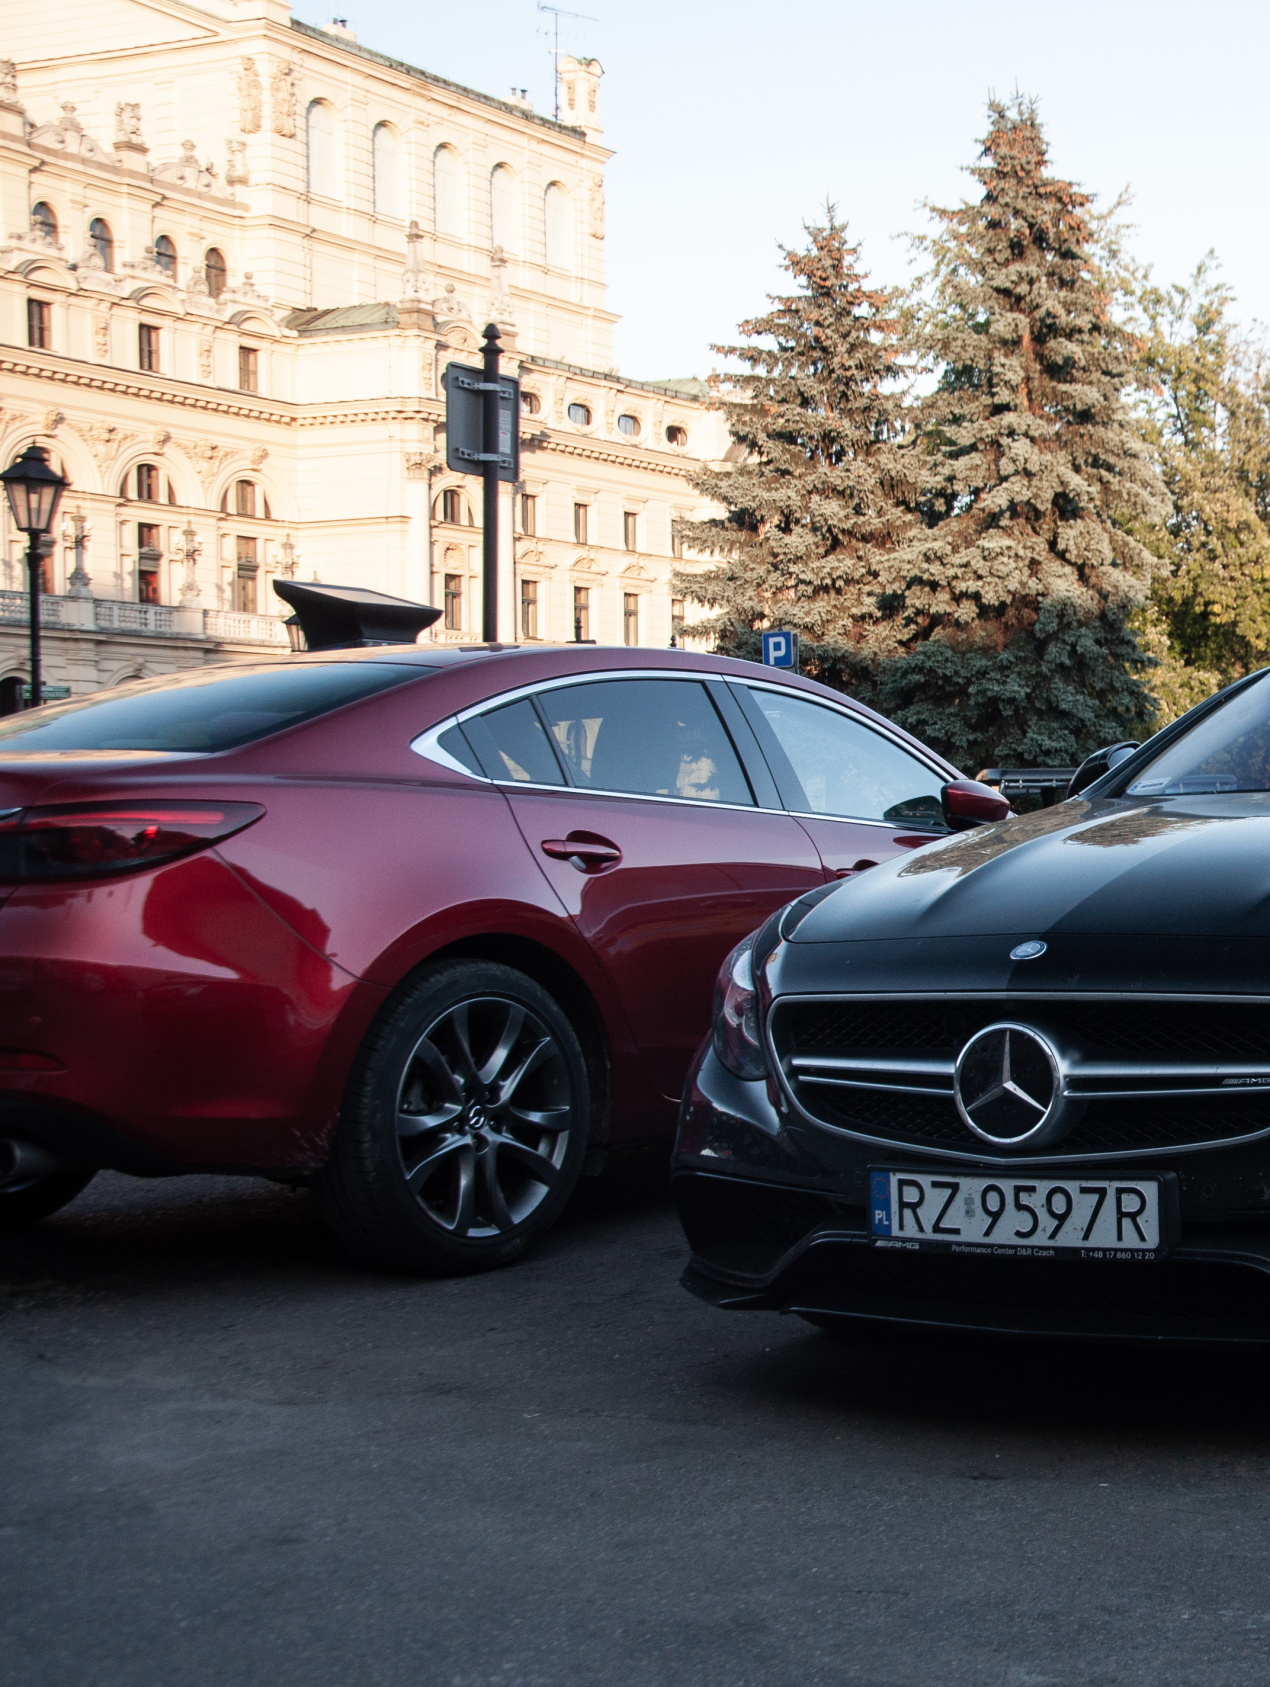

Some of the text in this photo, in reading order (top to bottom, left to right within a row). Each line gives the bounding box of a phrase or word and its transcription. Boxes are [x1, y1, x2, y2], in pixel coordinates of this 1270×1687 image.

[769, 637, 786, 665] P
[897, 1177, 1148, 1242] RZ 9597R
[875, 1209, 890, 1225] PL
[888, 1240, 920, 1250] AMG
[951, 1244, 992, 1254] Performance
[993, 1246, 1016, 1255] Center
[1017, 1248, 1032, 1256] D&R
[1080, 1250, 1088, 1258] T:
[1089, 1251, 1103, 1259] +48
[1106, 1251, 1115, 1259] 17
[1117, 1251, 1131, 1259] 860
[1145, 1252, 1155, 1260] 20
